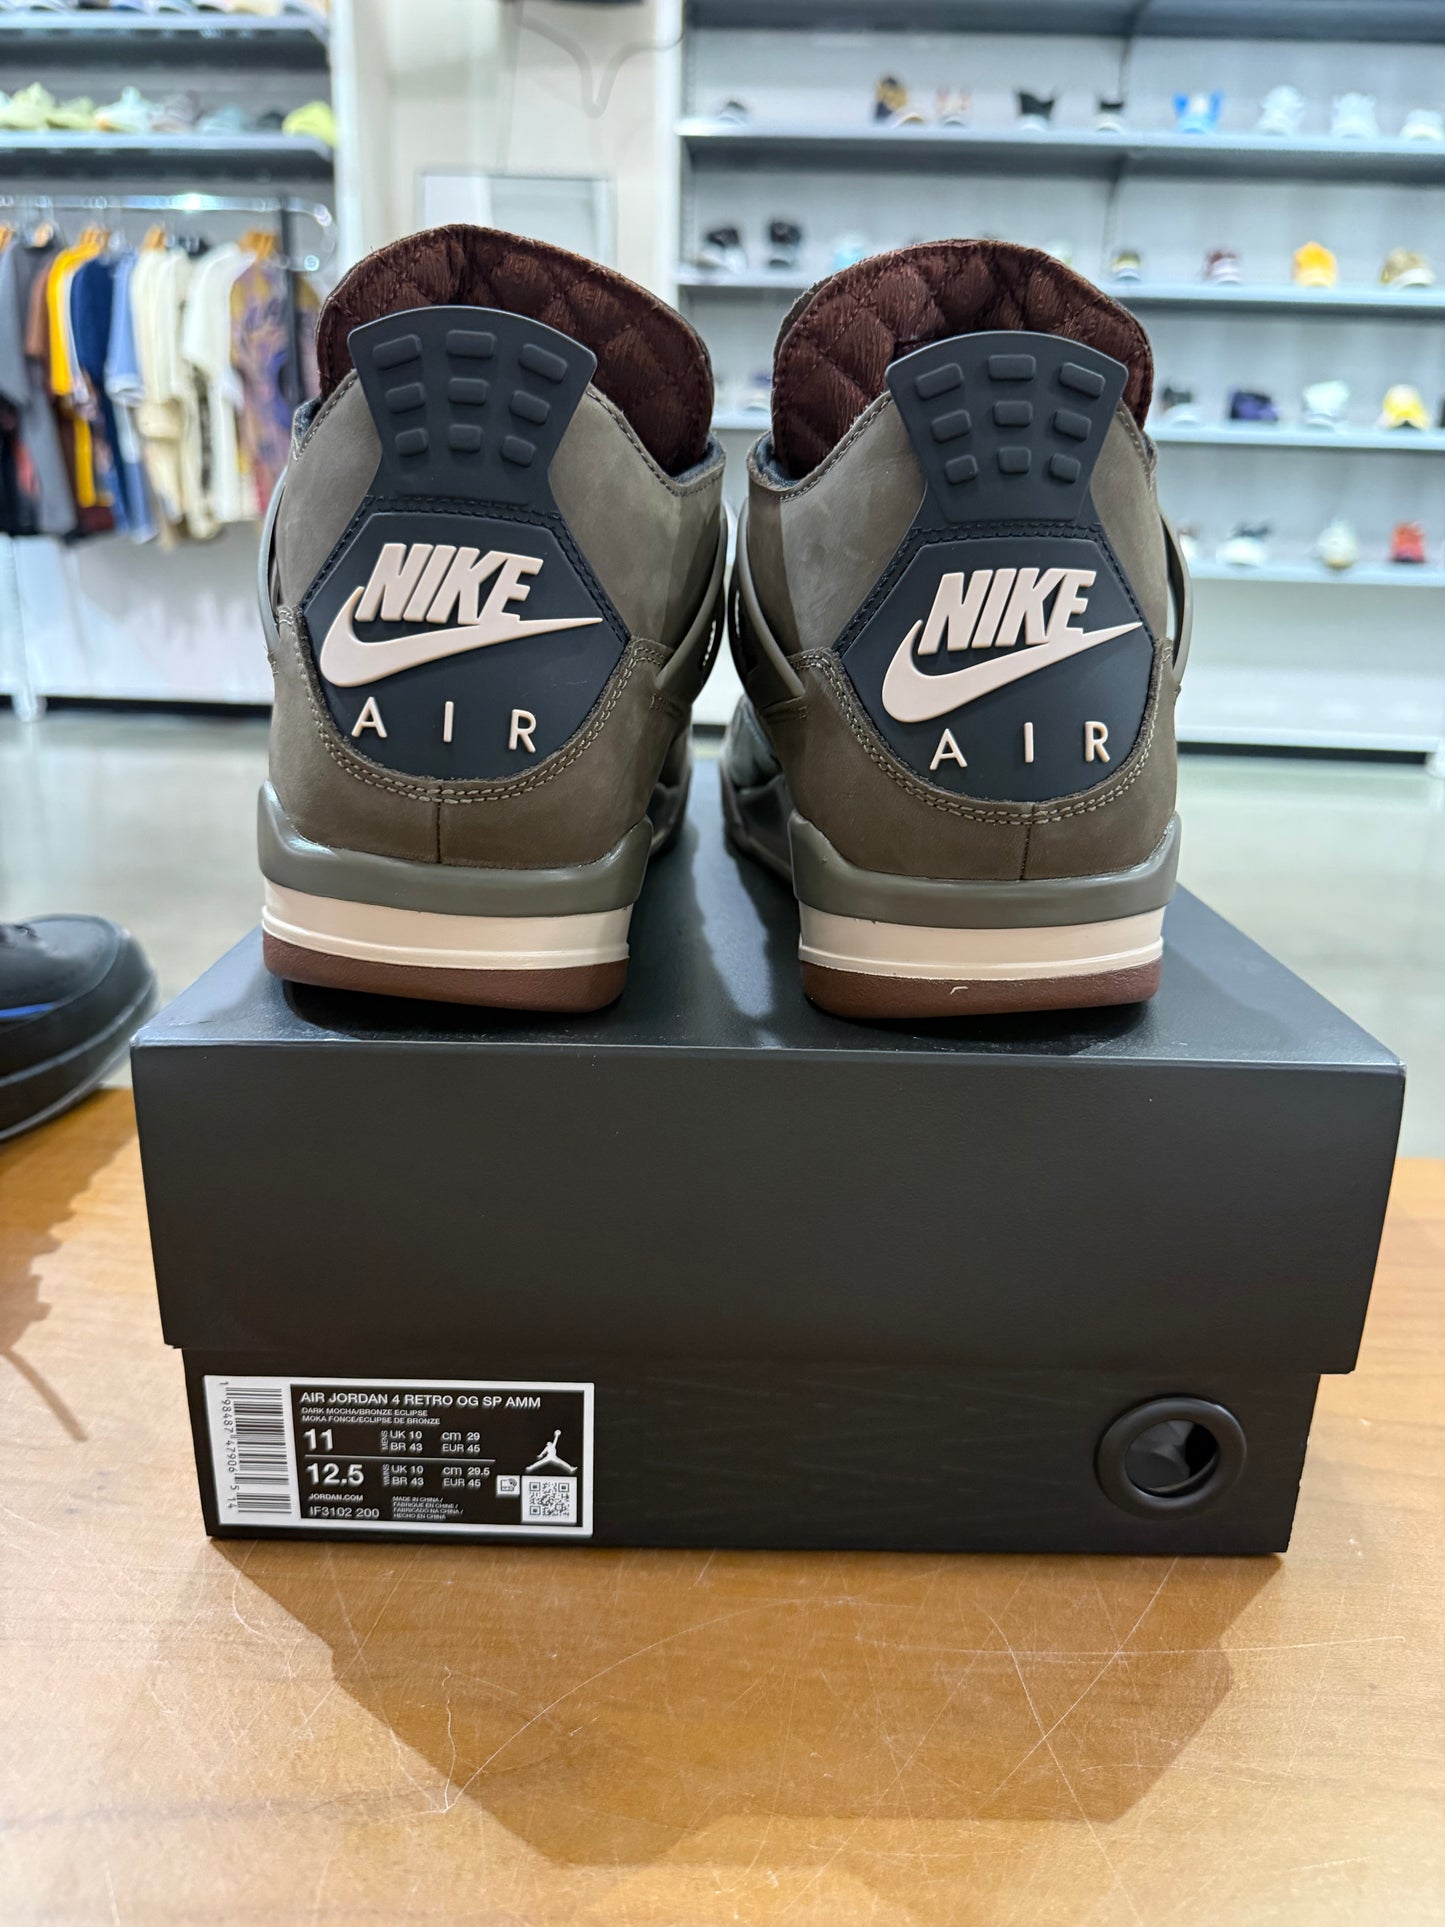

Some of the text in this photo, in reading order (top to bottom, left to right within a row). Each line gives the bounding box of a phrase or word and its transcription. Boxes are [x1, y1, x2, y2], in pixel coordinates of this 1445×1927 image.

[355, 543, 544, 625] NIKE
[917, 568, 1096, 655] NIKE
[351, 696, 537, 753] AIR
[929, 720, 1111, 771] AIR
[300, 1392, 541, 1408] AIR JORDAN 4 RETRO OG SP AMM
[221, 1400, 234, 1433] 98487
[301, 1406, 428, 1417] DARK MOCHA/BRONZE ECLIPSE
[303, 1428, 333, 1451] 11
[381, 1430, 389, 1450] MENS
[390, 1430, 422, 1439] UK 10
[466, 1432, 480, 1441] 29
[390, 1442, 423, 1451] BR 43
[441, 1444, 480, 1453] EUR 45
[225, 1440, 238, 1473] 47906
[307, 1463, 364, 1486] 12.5
[391, 1465, 424, 1474] UK 10
[467, 1467, 490, 1476] 29.5
[392, 1477, 424, 1486] BR 43
[443, 1478, 481, 1487] EUR 45
[308, 1493, 363, 1501] JORDAN.COM
[309, 1506, 379, 1518] IF3102 200
